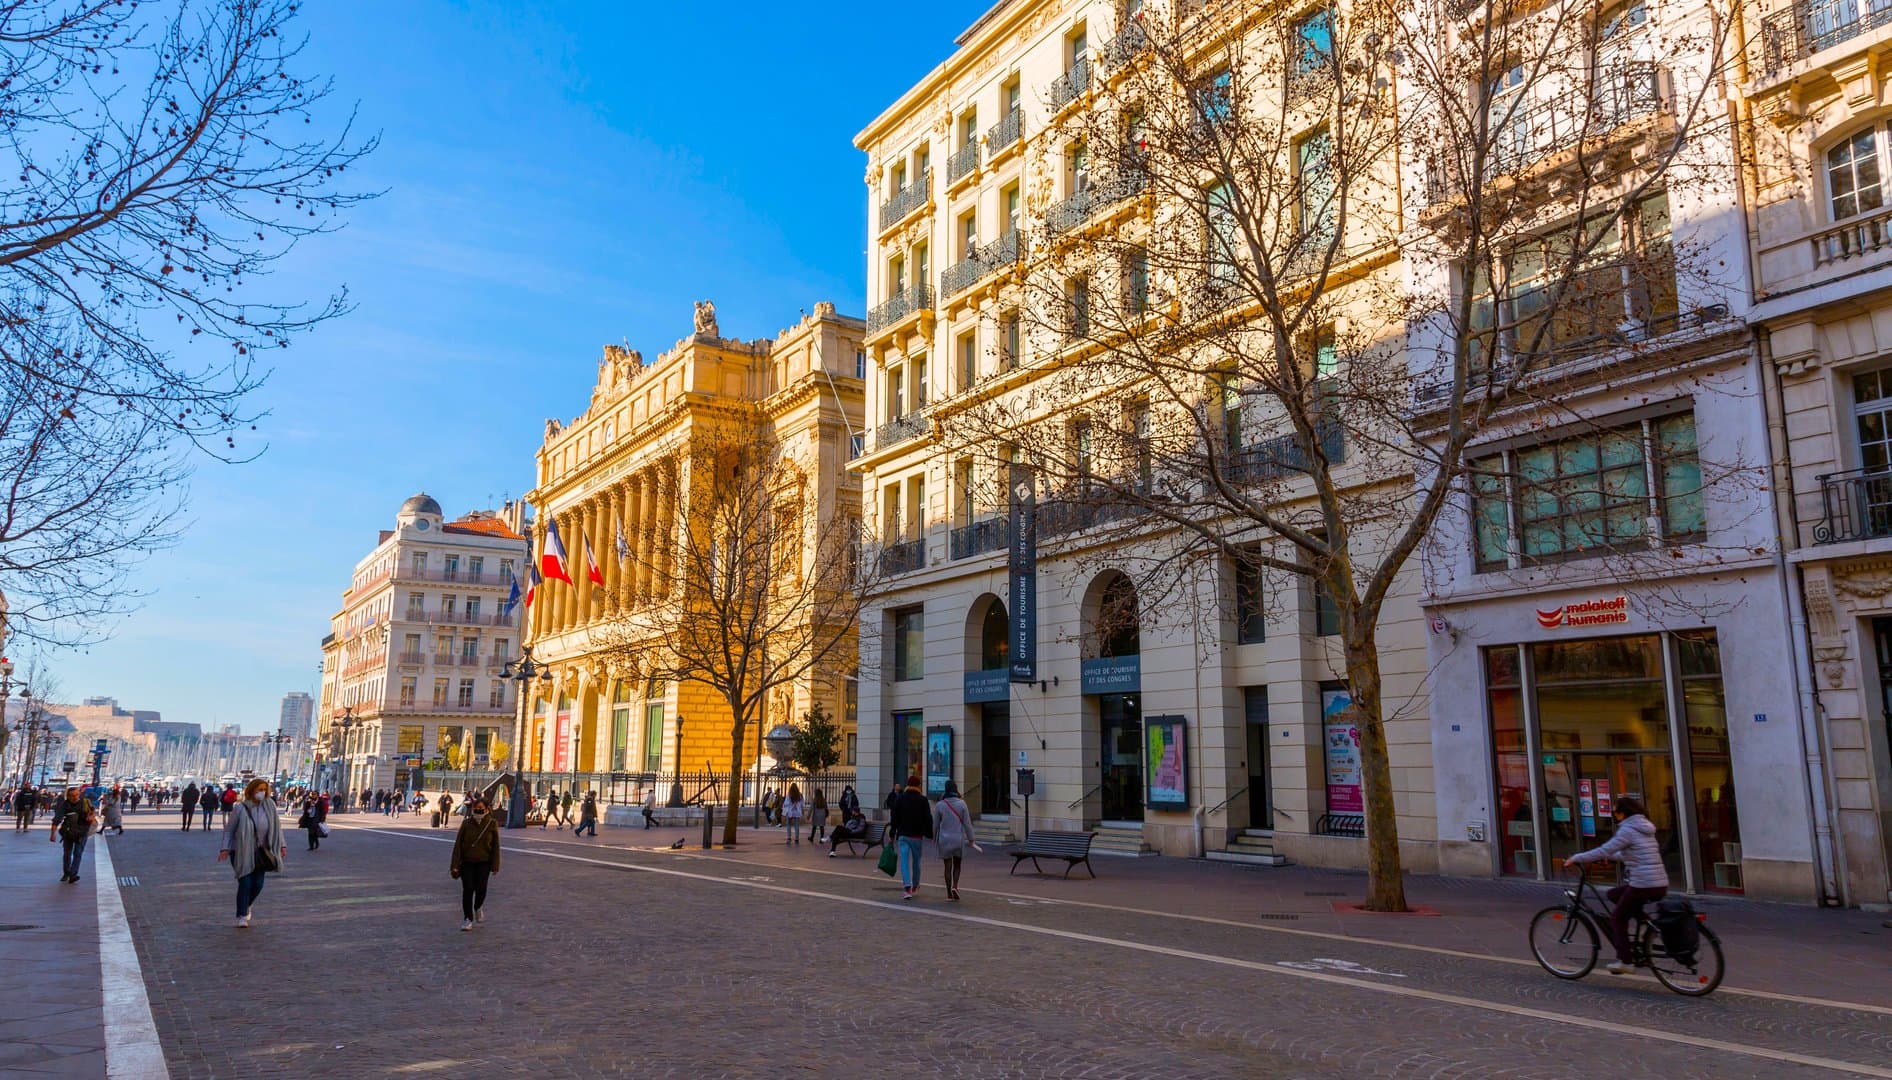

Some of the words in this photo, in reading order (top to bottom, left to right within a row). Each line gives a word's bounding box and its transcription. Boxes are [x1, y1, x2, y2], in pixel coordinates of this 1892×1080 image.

[1019, 576, 1027, 616] TOURISME
[1567, 597, 1626, 613] malakoff
[1019, 618, 1027, 630] DE
[1567, 610, 1627, 626] humanis
[1019, 632, 1027, 659] OFFICE
